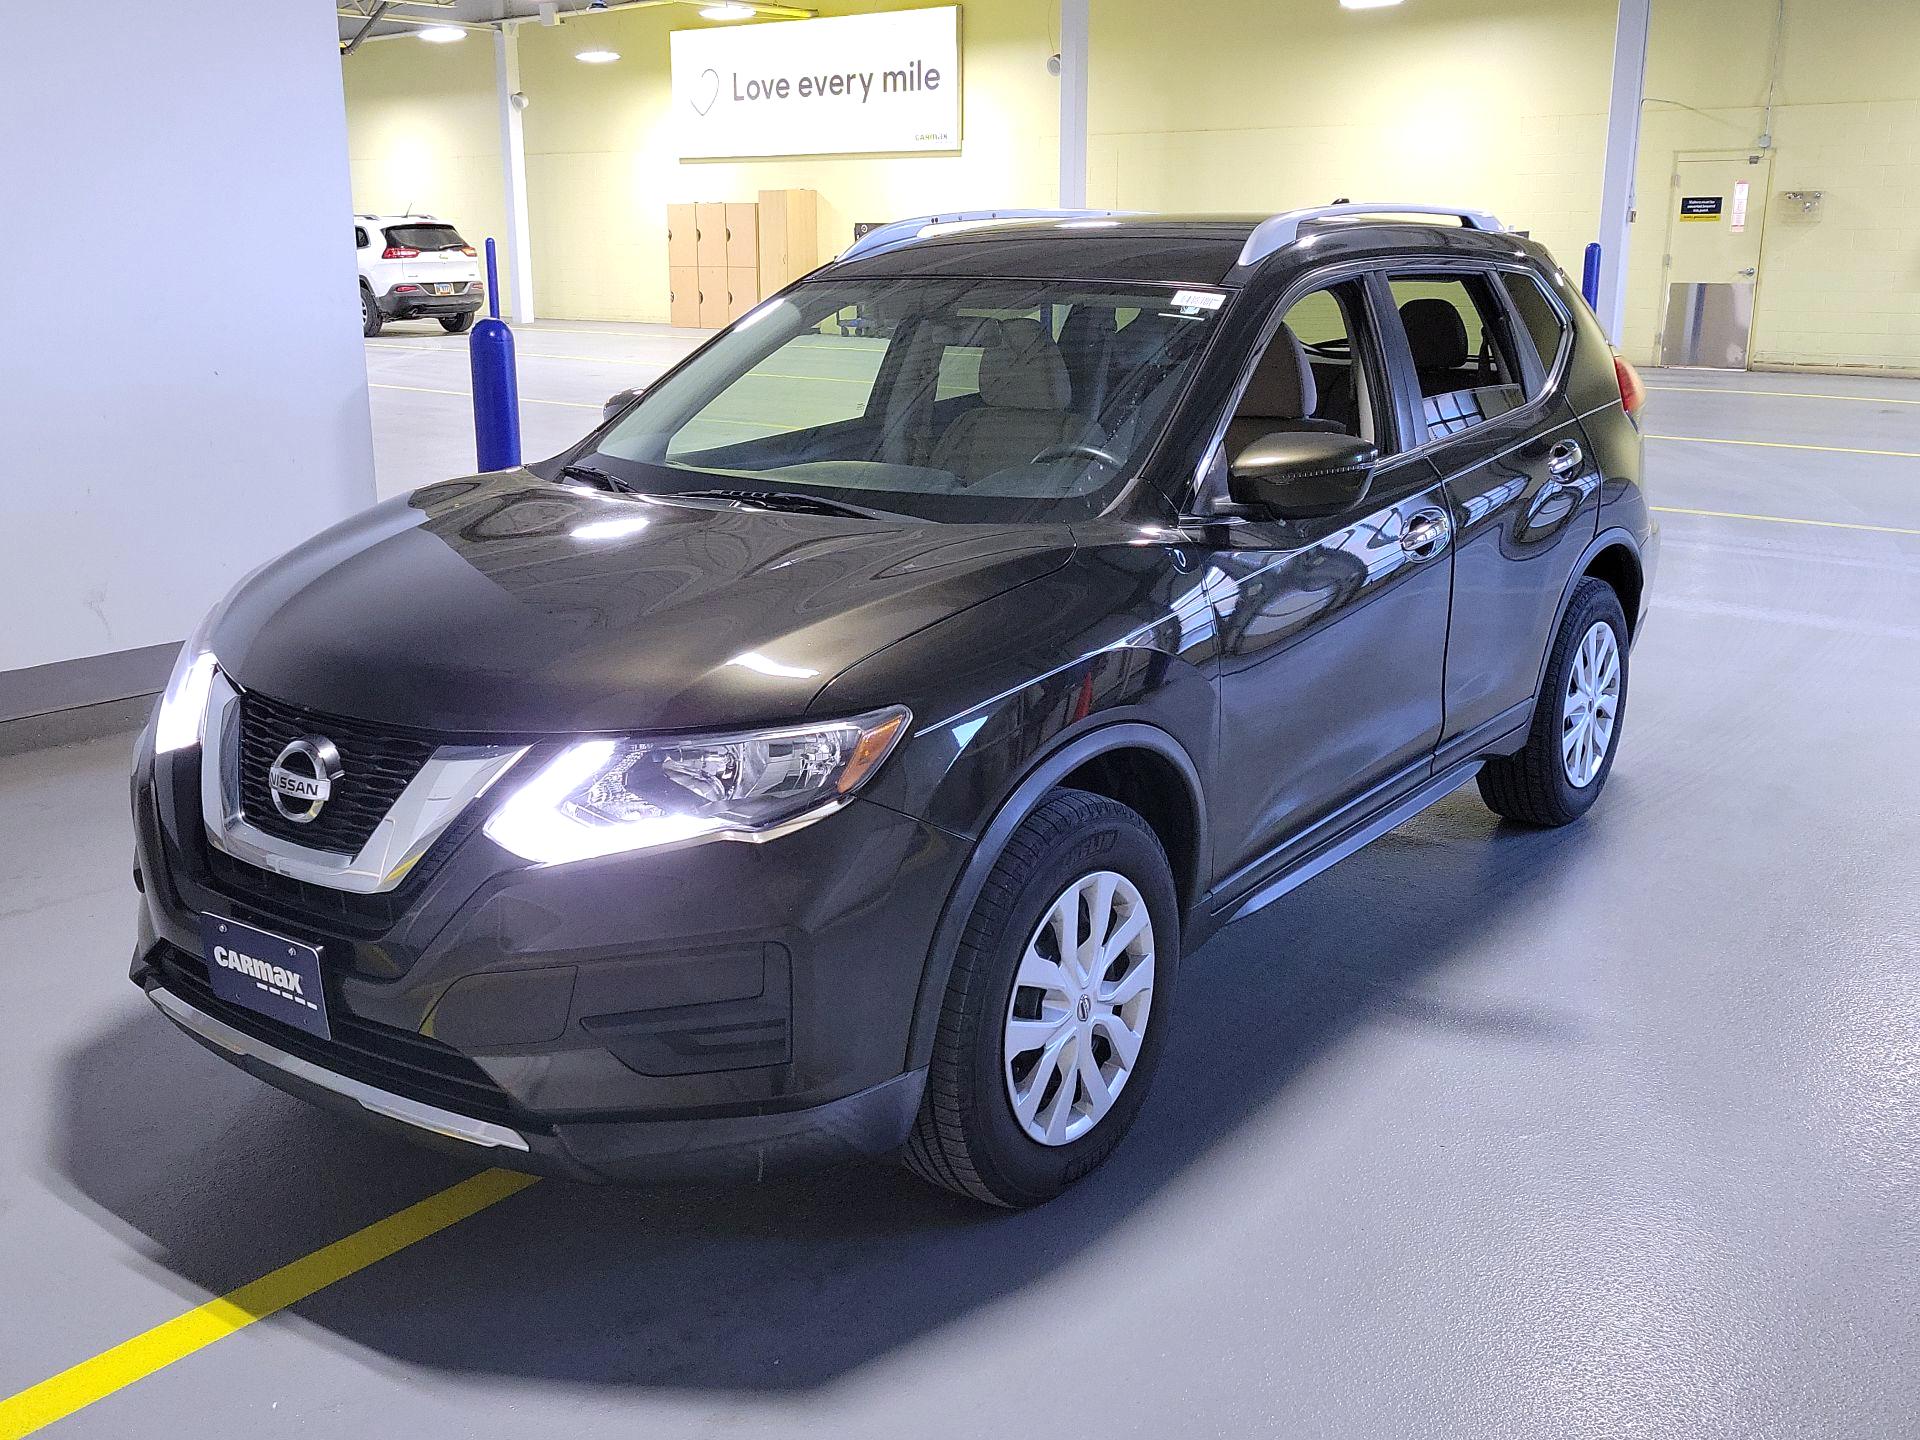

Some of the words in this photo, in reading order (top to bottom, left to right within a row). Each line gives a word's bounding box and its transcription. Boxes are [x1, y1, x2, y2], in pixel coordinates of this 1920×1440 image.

[733, 72, 790, 101] Love
[798, 72, 874, 104] every
[883, 59, 941, 92] mile
[270, 771, 319, 796] NISSAN
